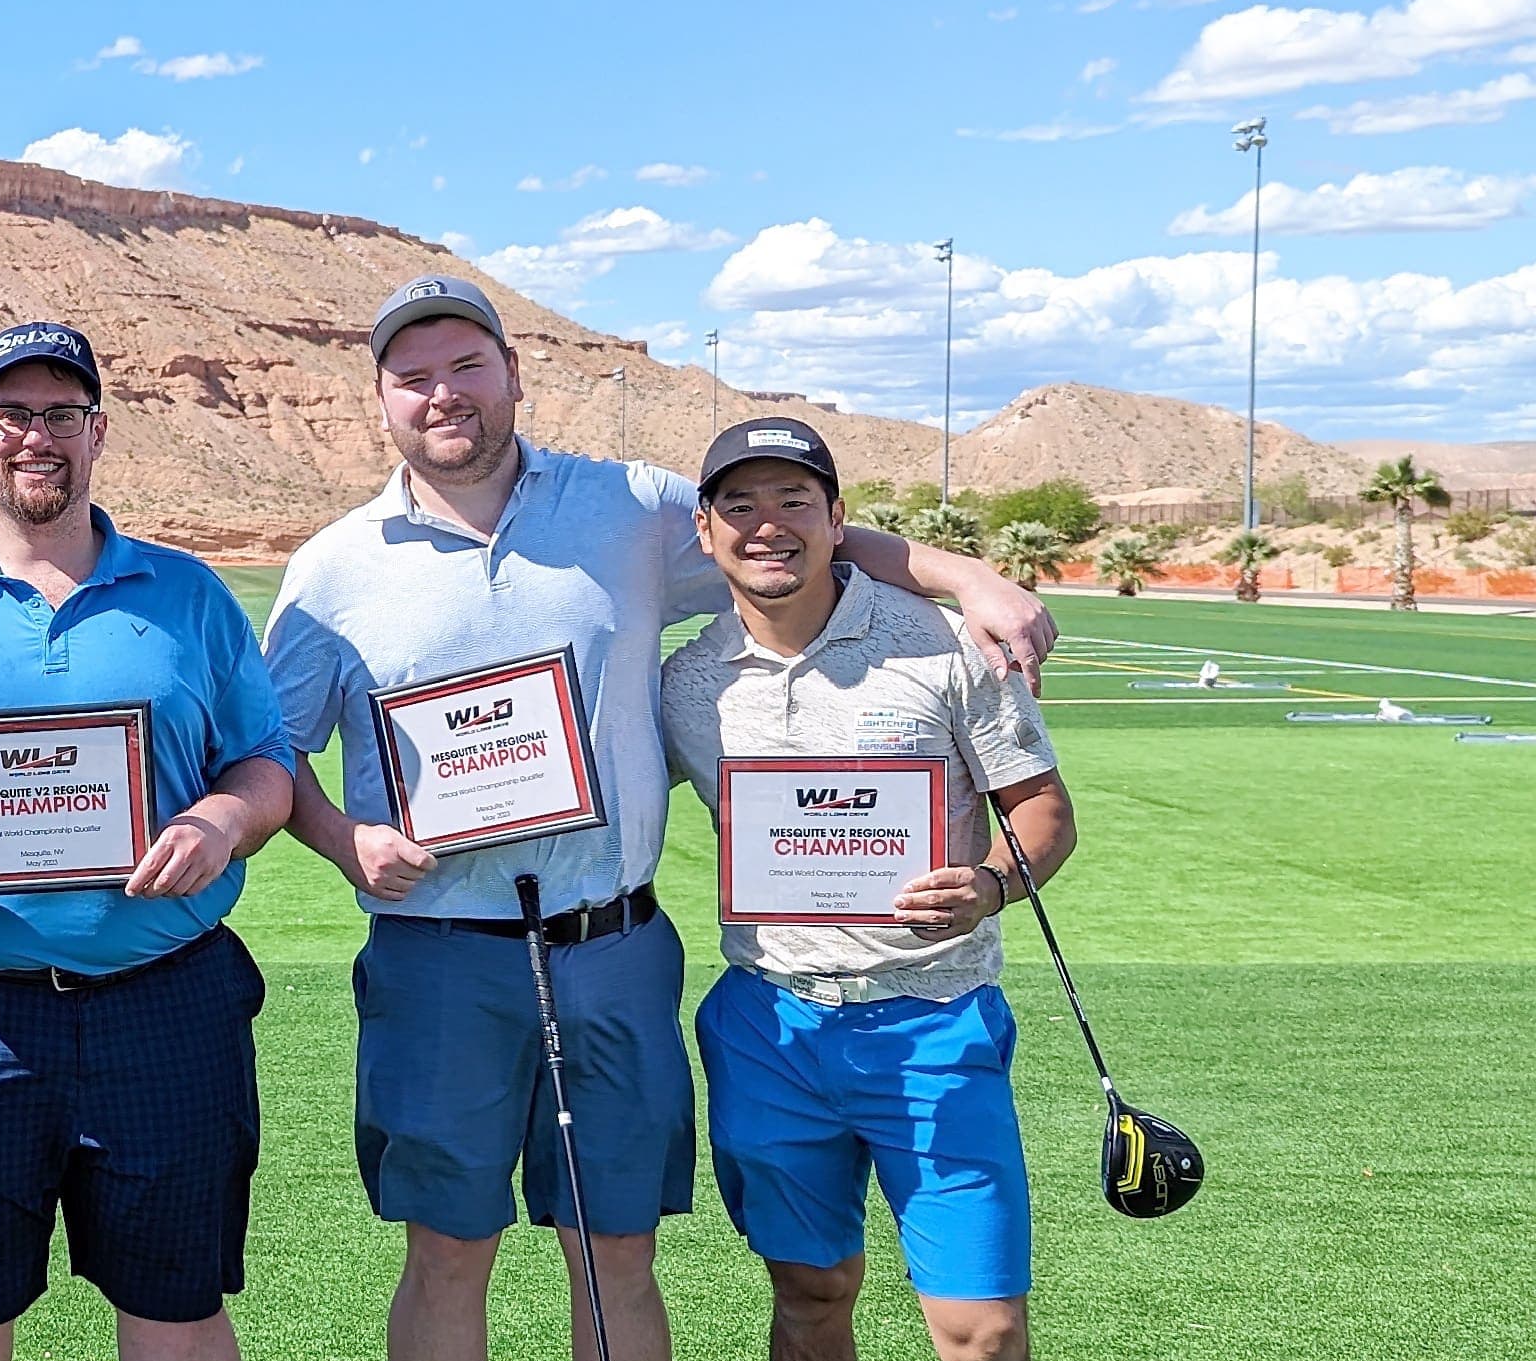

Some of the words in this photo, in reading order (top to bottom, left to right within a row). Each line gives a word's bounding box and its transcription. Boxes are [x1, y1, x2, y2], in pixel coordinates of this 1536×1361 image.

[445, 698, 513, 730] WLD
[0, 745, 78, 770] WLD
[431, 745, 478, 763] MESQUITE
[480, 742, 494, 752] V2
[496, 730, 548, 748] REGIONAL
[438, 741, 546, 778] CHAMPION
[35, 786, 50, 796] V2
[53, 783, 111, 795] REGIONAL
[796, 789, 878, 809] WLD
[770, 828, 826, 838] MESQUITE
[830, 828, 845, 838] V2
[850, 828, 910, 838] REGIONAL
[775, 839, 904, 856] CHAMPION
